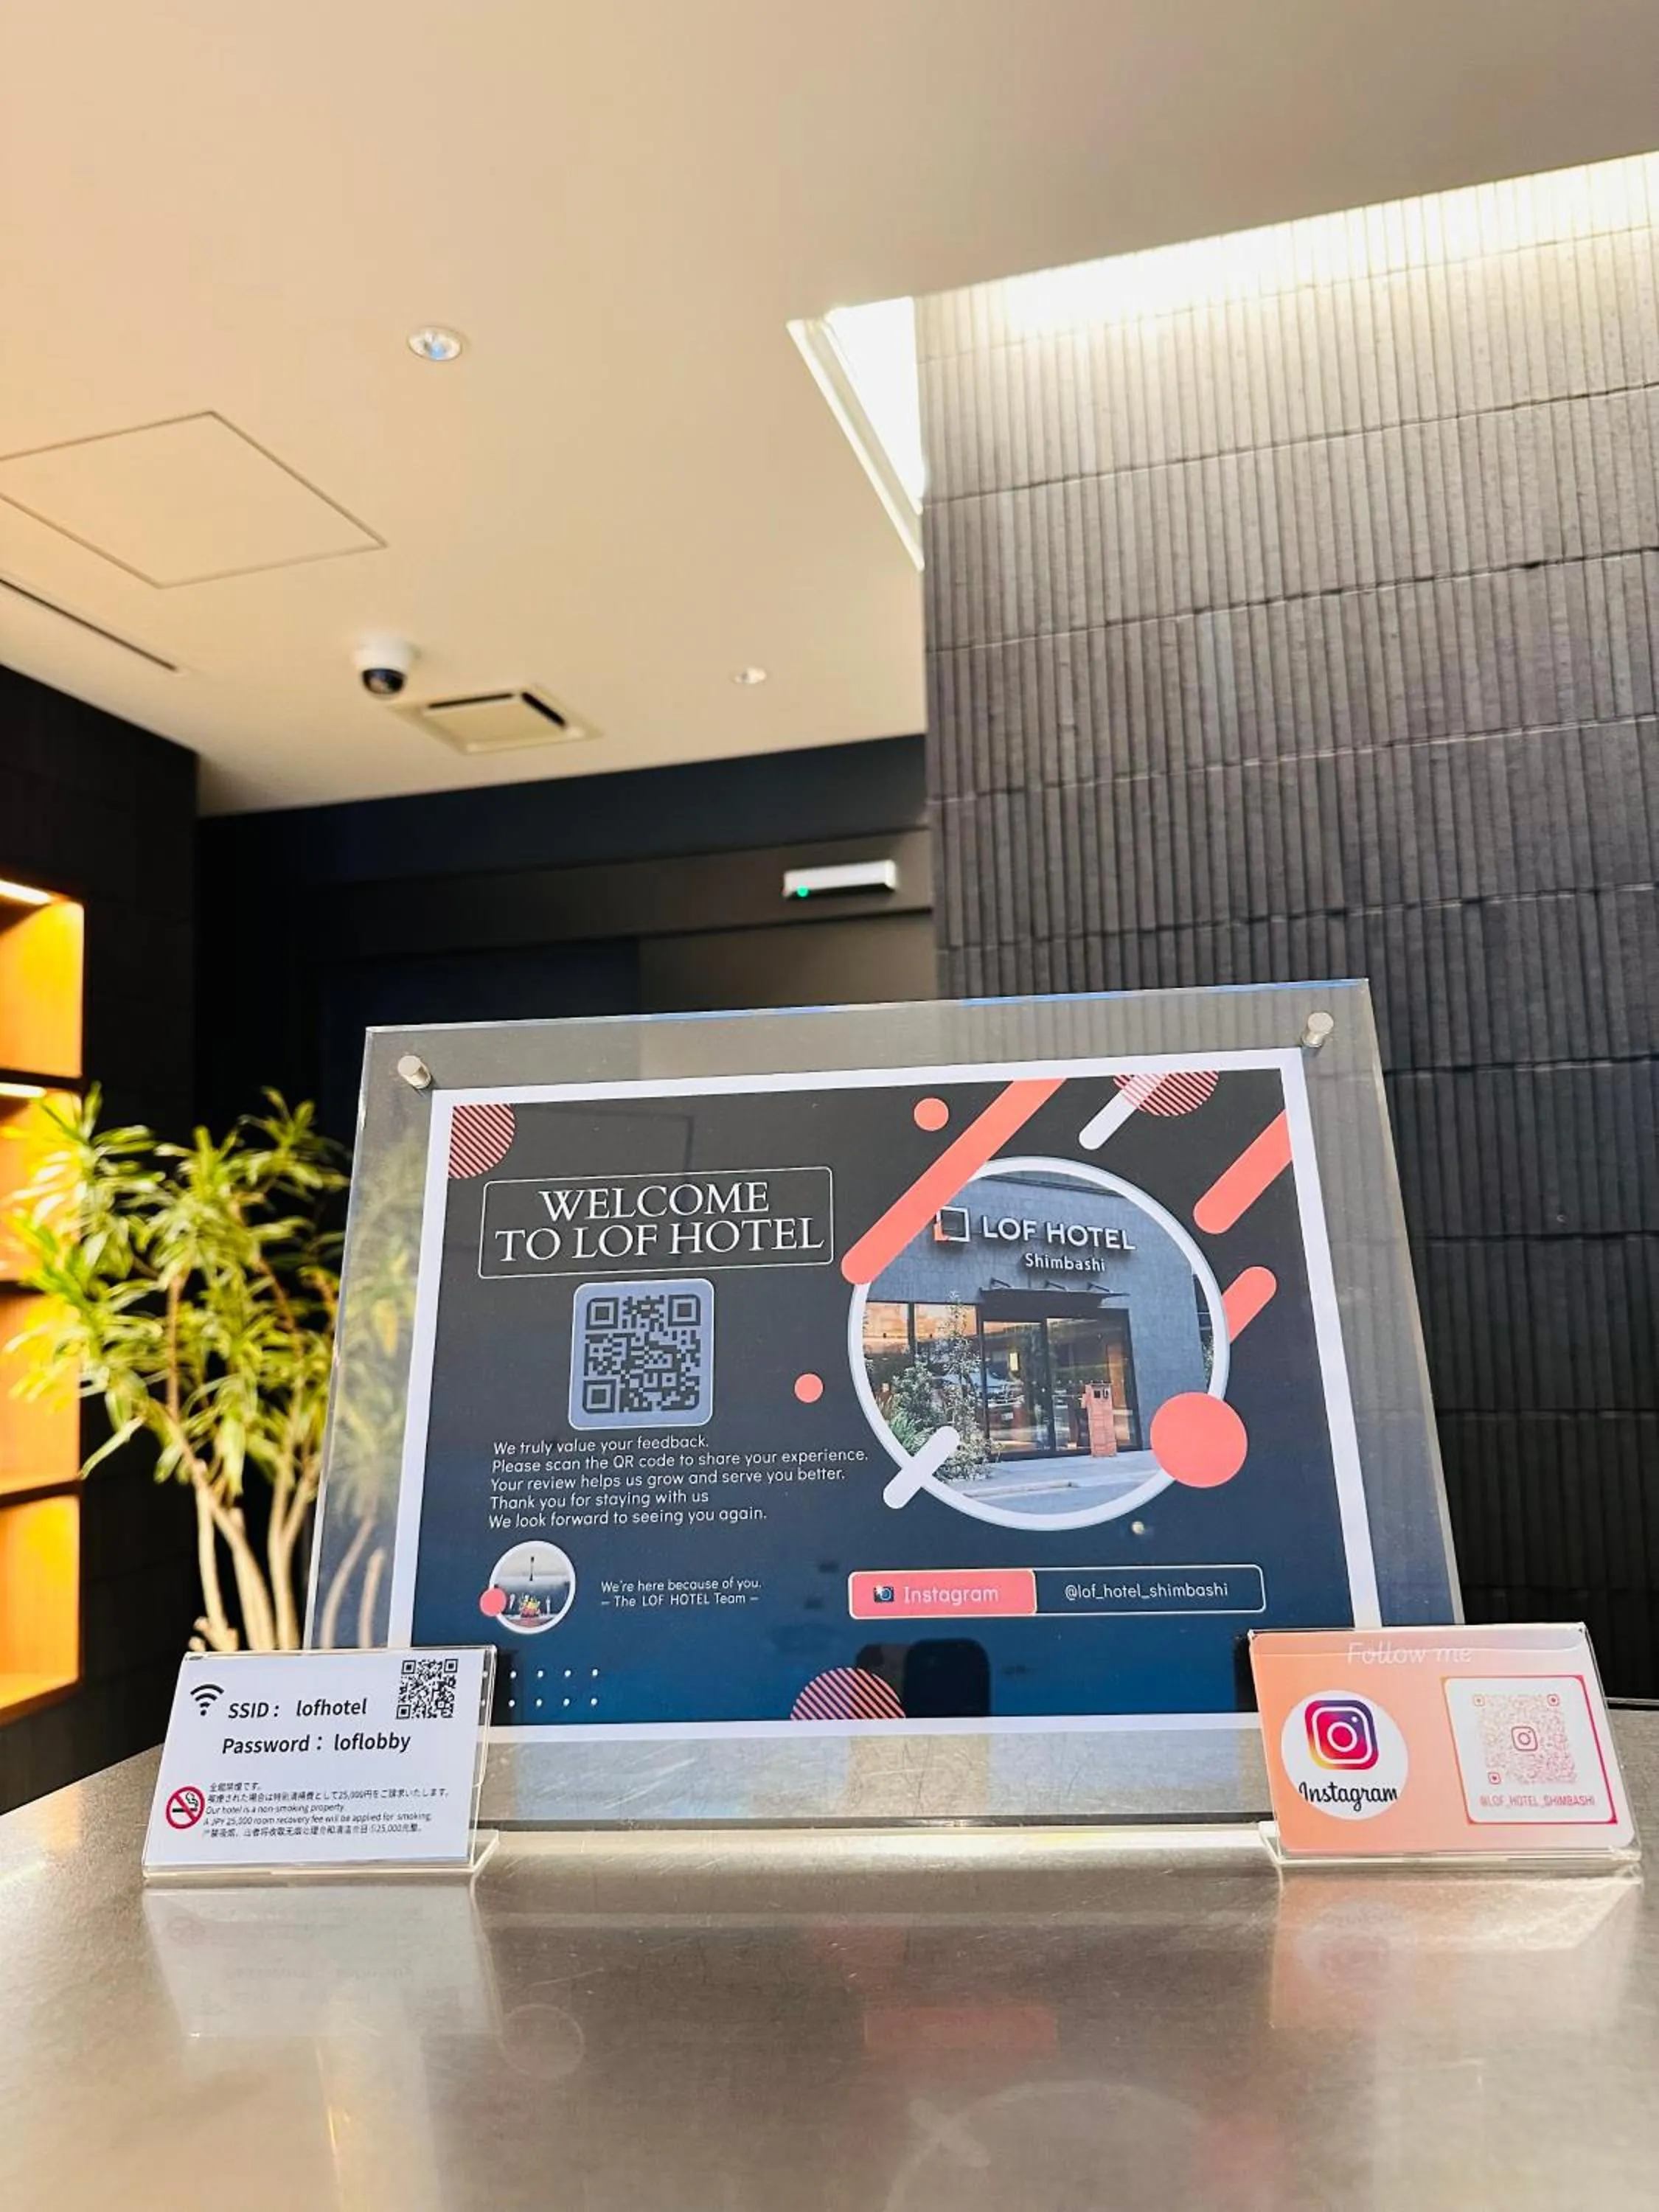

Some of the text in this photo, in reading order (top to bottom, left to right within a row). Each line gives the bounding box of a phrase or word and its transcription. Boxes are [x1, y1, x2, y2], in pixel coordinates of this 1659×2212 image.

[538, 1182, 769, 1222] WELCOME
[495, 1217, 825, 1262] TO LOF HOTEL
[982, 1215, 1136, 1250] LOF HOTEL
[1024, 1253, 1106, 1272] Shimbashi
[493, 1434, 709, 1456] We truly value your feedback.
[492, 1449, 869, 1473] Please scan the QR code to share your experience.
[490, 1467, 846, 1492] Your review helps us grow and serve you better.
[490, 1489, 709, 1511] Thank you for staying with us
[489, 1506, 767, 1529] We look forward to seeing you again.
[601, 1576, 762, 1593] We're here because of you.
[1065, 1583, 1228, 1601] @lof_hotel_shimbashi
[613, 1595, 636, 1607] The
[642, 1594, 664, 1607] LOF
[670, 1593, 710, 1605] HOTEL
[714, 1593, 745, 1604] Team
[902, 1585, 998, 1607] Instagram
[1347, 1641, 1472, 1665] Follow me
[296, 1697, 367, 1717] lofhotel
[334, 1731, 411, 1753] loflobby
[1299, 1781, 1397, 1812] Instagram
[223, 1805, 242, 1814] hotel
